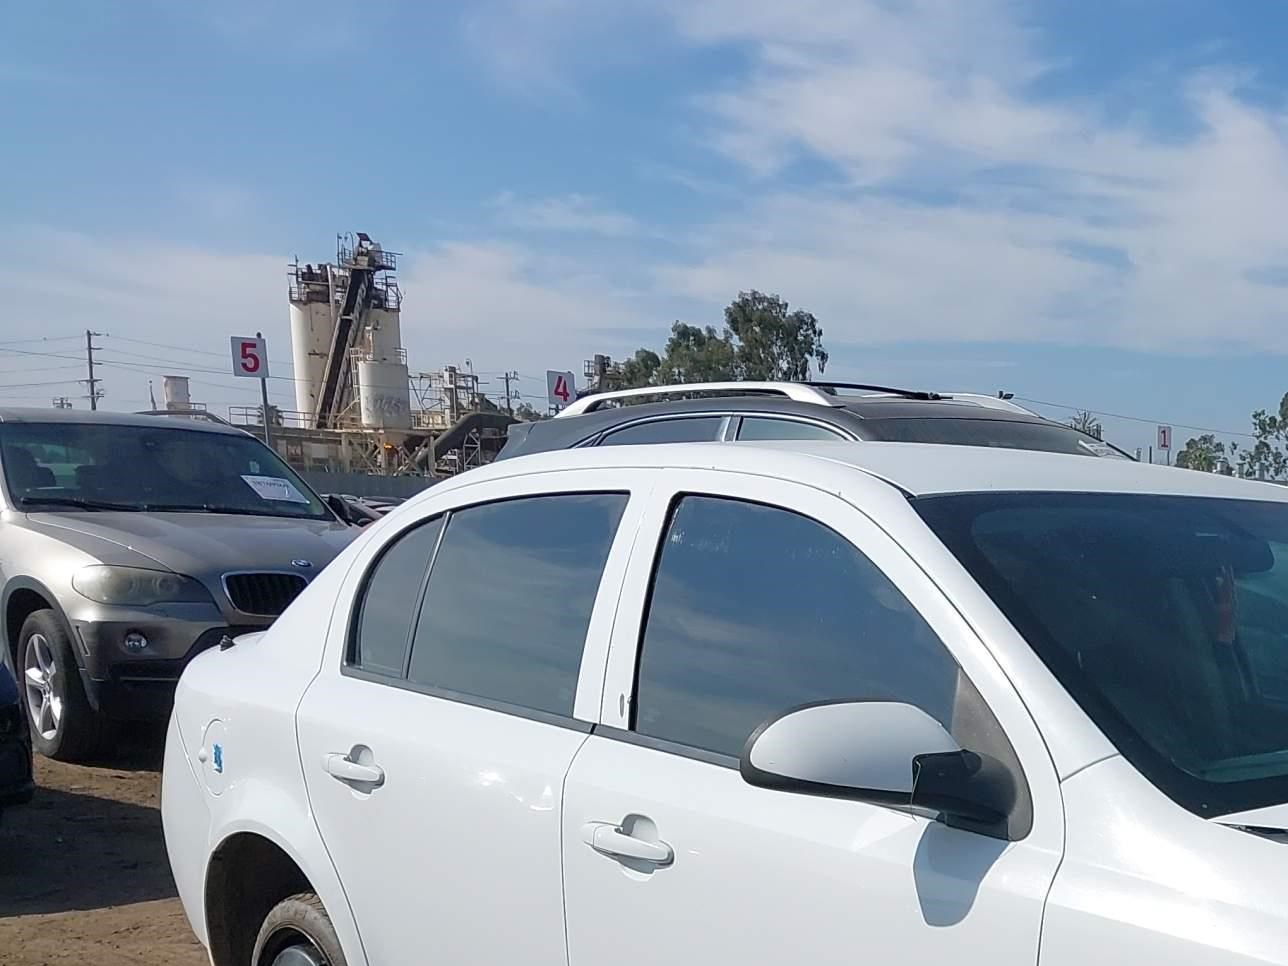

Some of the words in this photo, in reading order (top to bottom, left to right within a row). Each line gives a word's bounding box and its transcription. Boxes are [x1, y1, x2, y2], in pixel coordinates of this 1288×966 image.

[240, 342, 260, 373] 5
[554, 375, 570, 402] 4
[1160, 429, 1169, 448] 1
